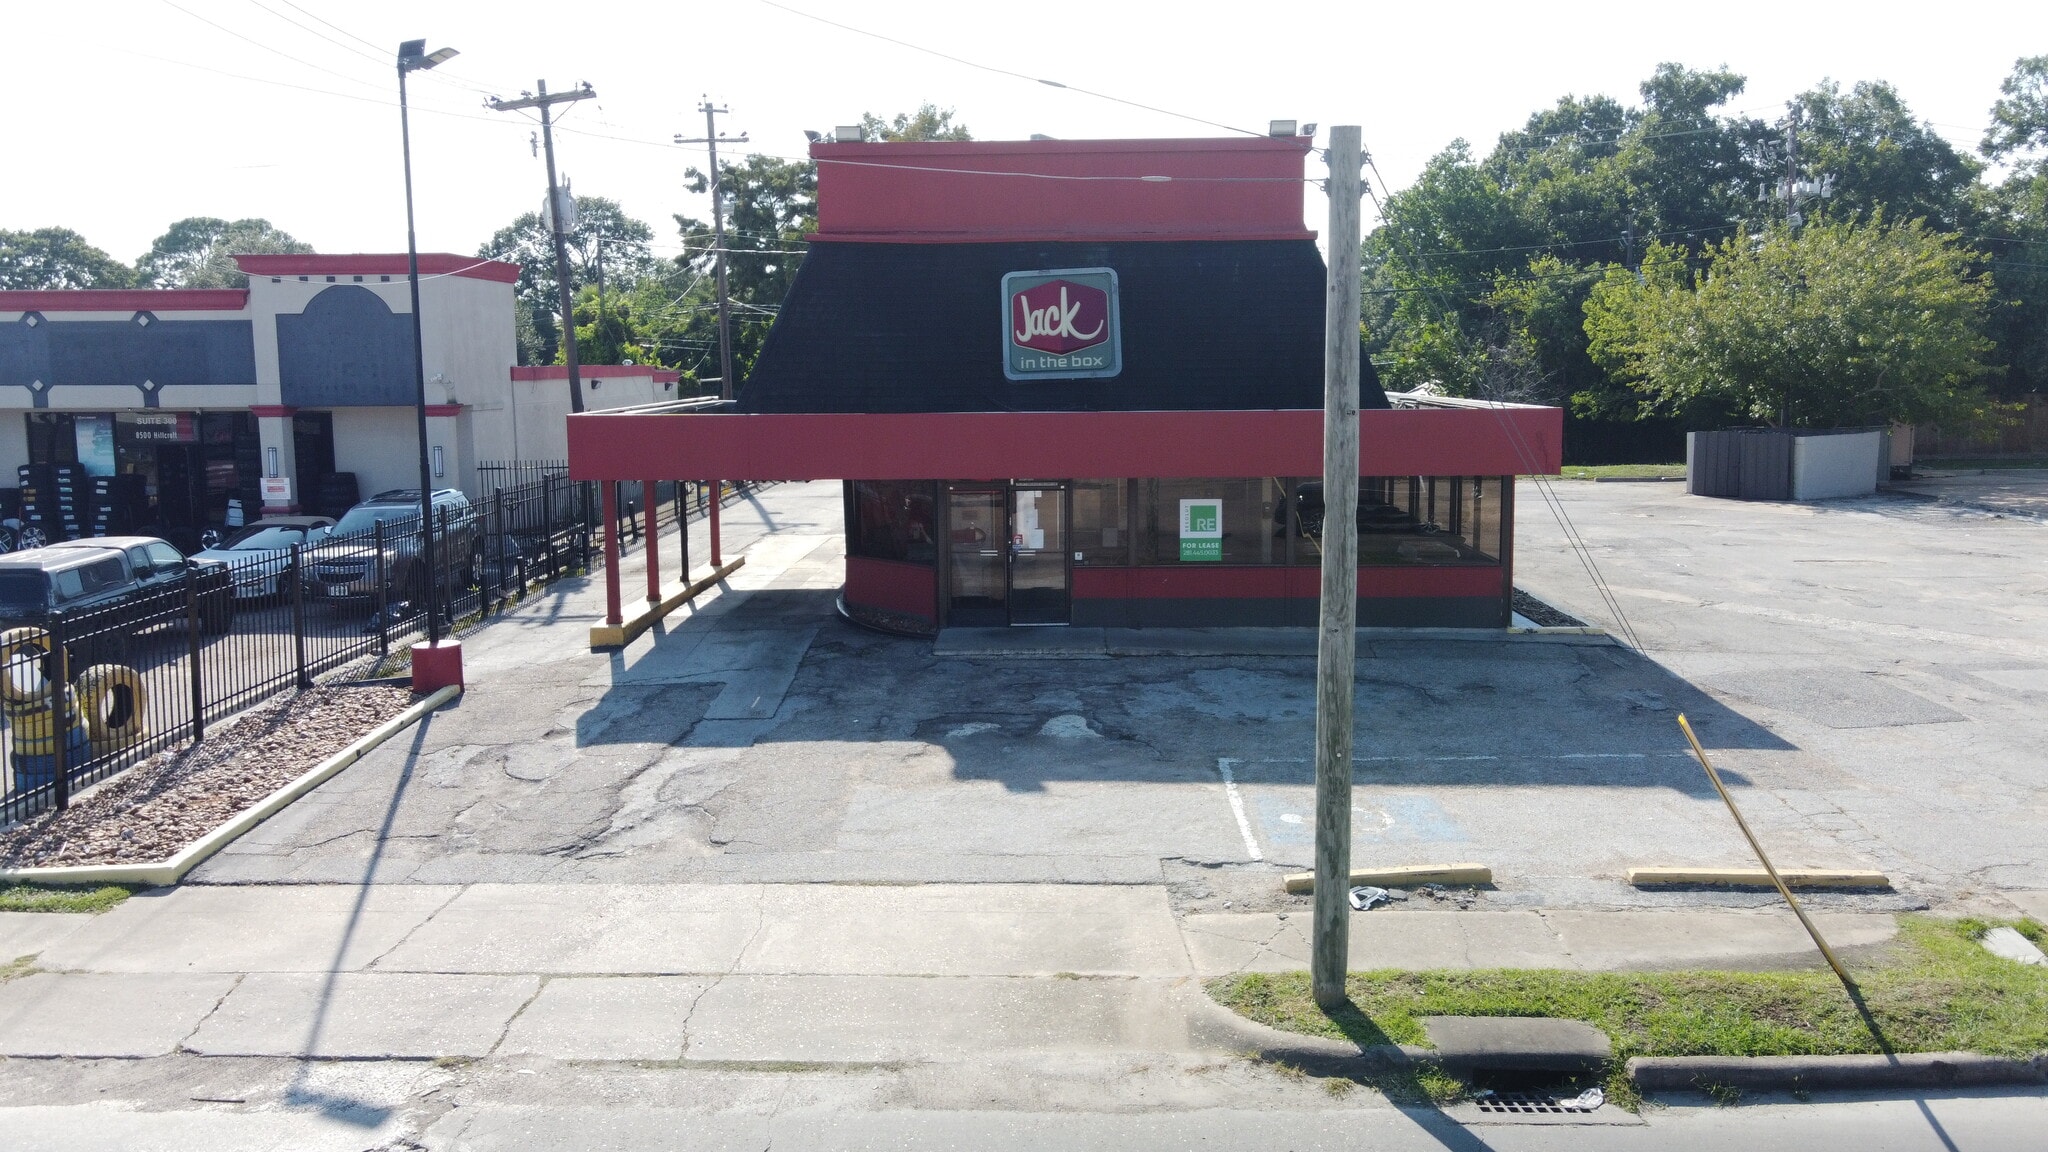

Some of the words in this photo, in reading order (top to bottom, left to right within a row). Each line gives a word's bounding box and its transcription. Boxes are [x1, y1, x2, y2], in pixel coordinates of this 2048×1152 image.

[1016, 286, 1104, 342] Jack
[1021, 357, 1035, 368] in
[1040, 356, 1067, 368] the
[1072, 355, 1102, 367] box
[136, 417, 161, 425] SUITE
[163, 417, 177, 425] 300
[135, 431, 151, 439] 8500
[1197, 518, 1216, 531] RE
